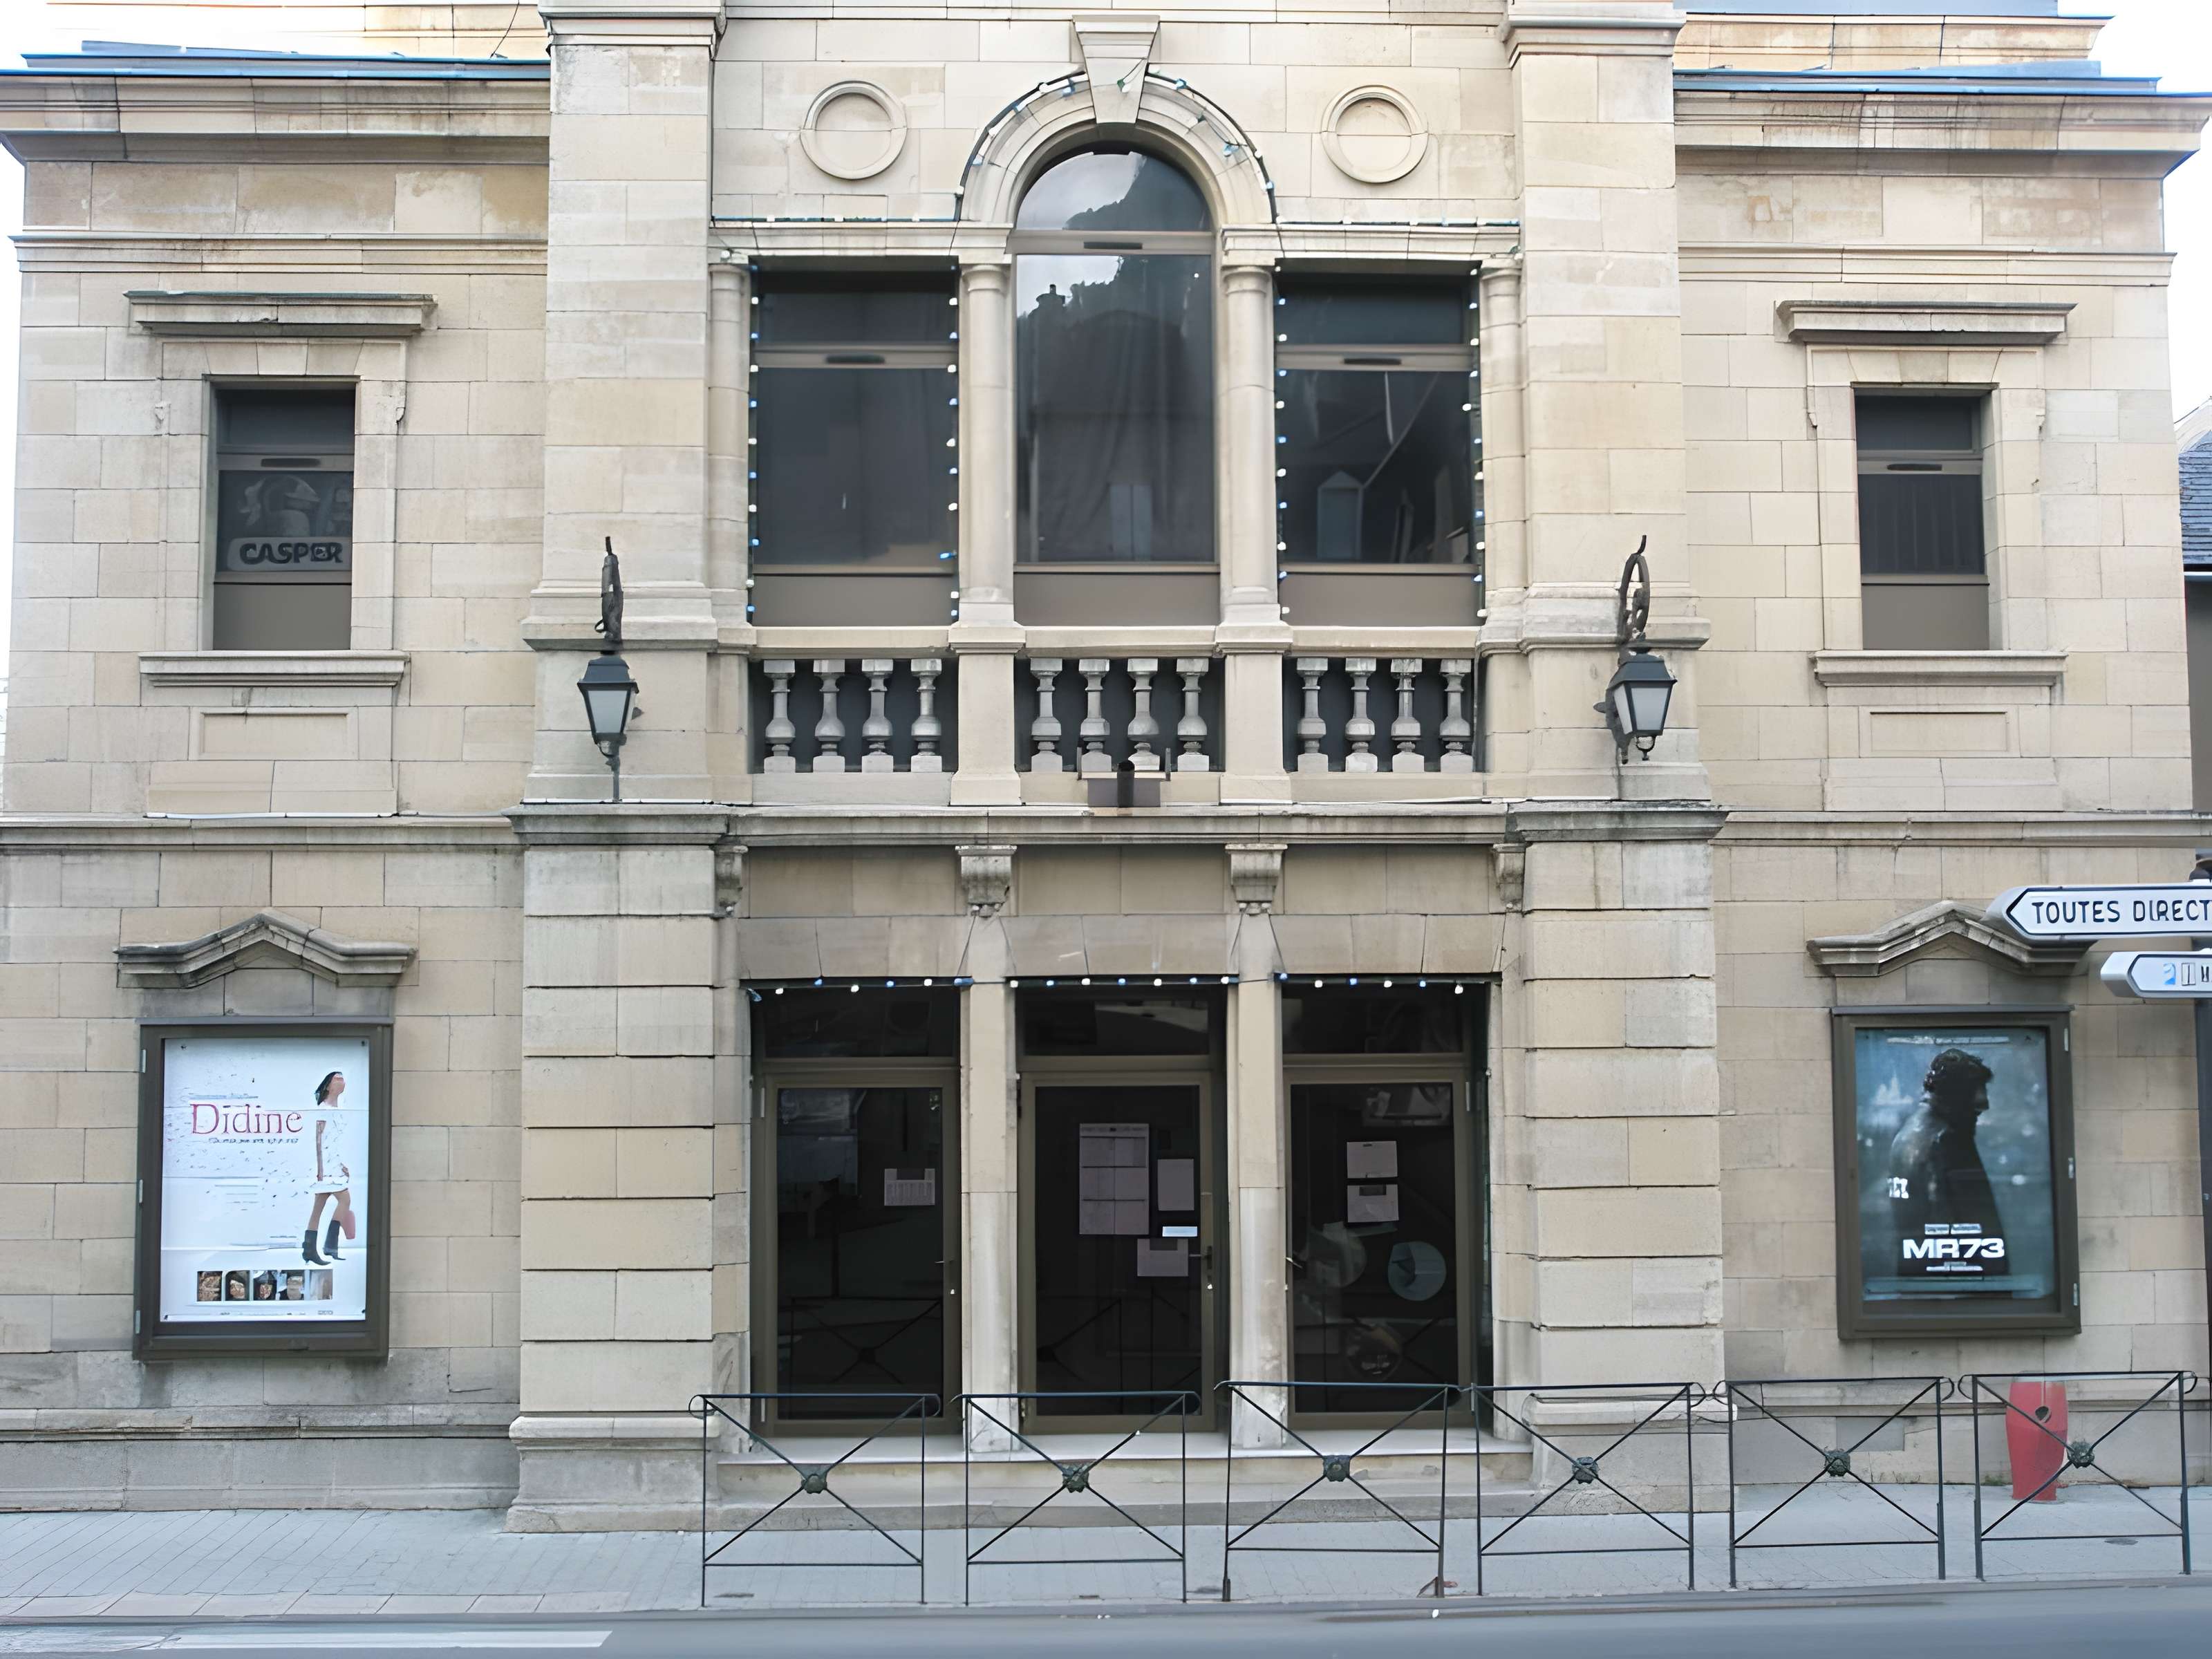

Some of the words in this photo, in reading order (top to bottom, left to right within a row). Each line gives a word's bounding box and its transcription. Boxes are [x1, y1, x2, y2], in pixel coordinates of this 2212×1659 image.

[239, 542, 344, 565] CASPER
[2031, 900, 2121, 924] TOUTES
[190, 1103, 303, 1134] Didine
[1902, 1237, 2005, 1259] MR73
